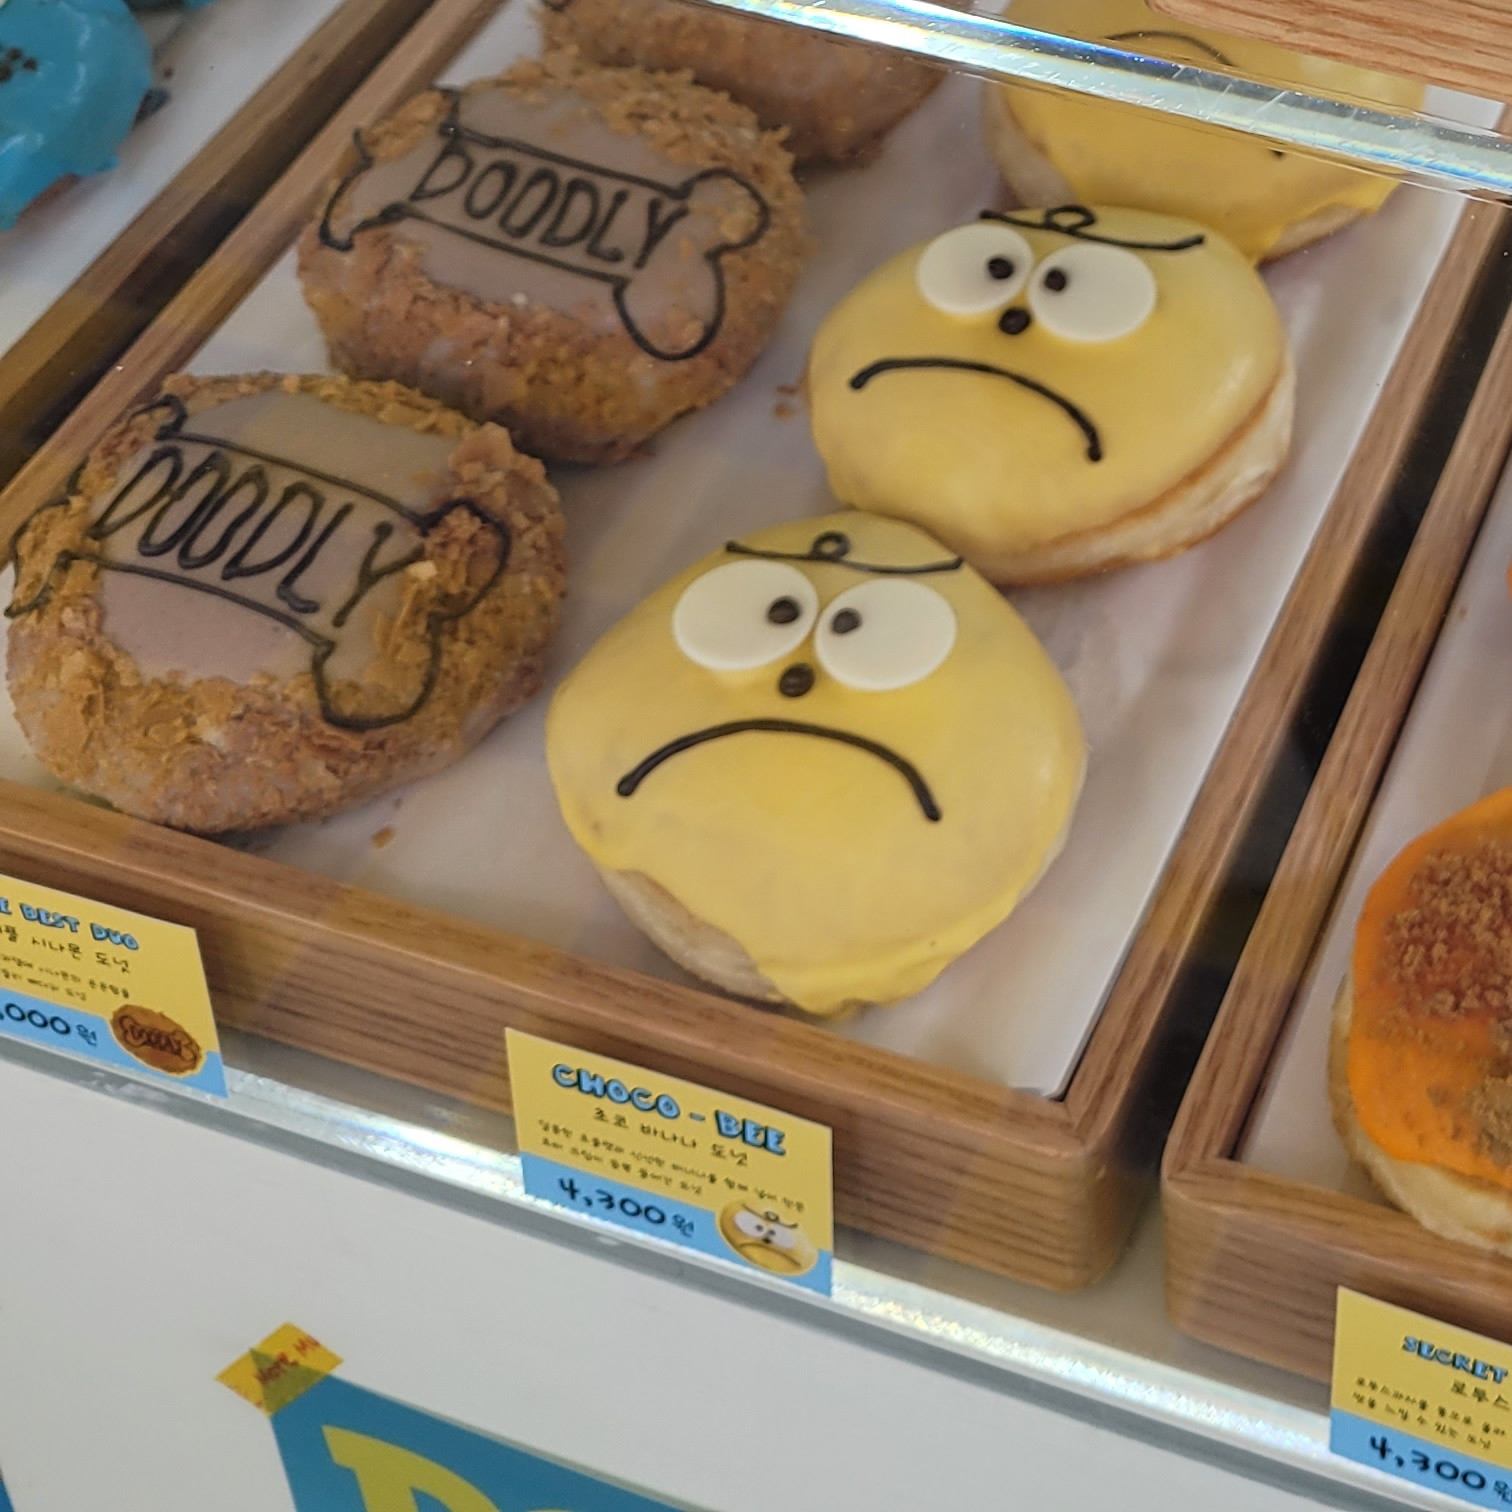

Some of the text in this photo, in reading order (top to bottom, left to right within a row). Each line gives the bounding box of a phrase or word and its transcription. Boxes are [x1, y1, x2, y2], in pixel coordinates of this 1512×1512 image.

[407, 143, 694, 269] DOODLY
[88, 445, 425, 629] DOODLY
[20, 903, 79, 933] BEST
[90, 922, 139, 950] DUO
[32, 936, 82, 960] 시나몬
[96, 952, 130, 973] 도넛
[552, 1063, 680, 1120] CHOCO
[715, 1110, 786, 1156] BEE
[594, 1107, 748, 1166] 초코 바나나 도넛
[1402, 1335, 1508, 1384] SECRET
[1452, 1380, 1511, 1411] 로투스
